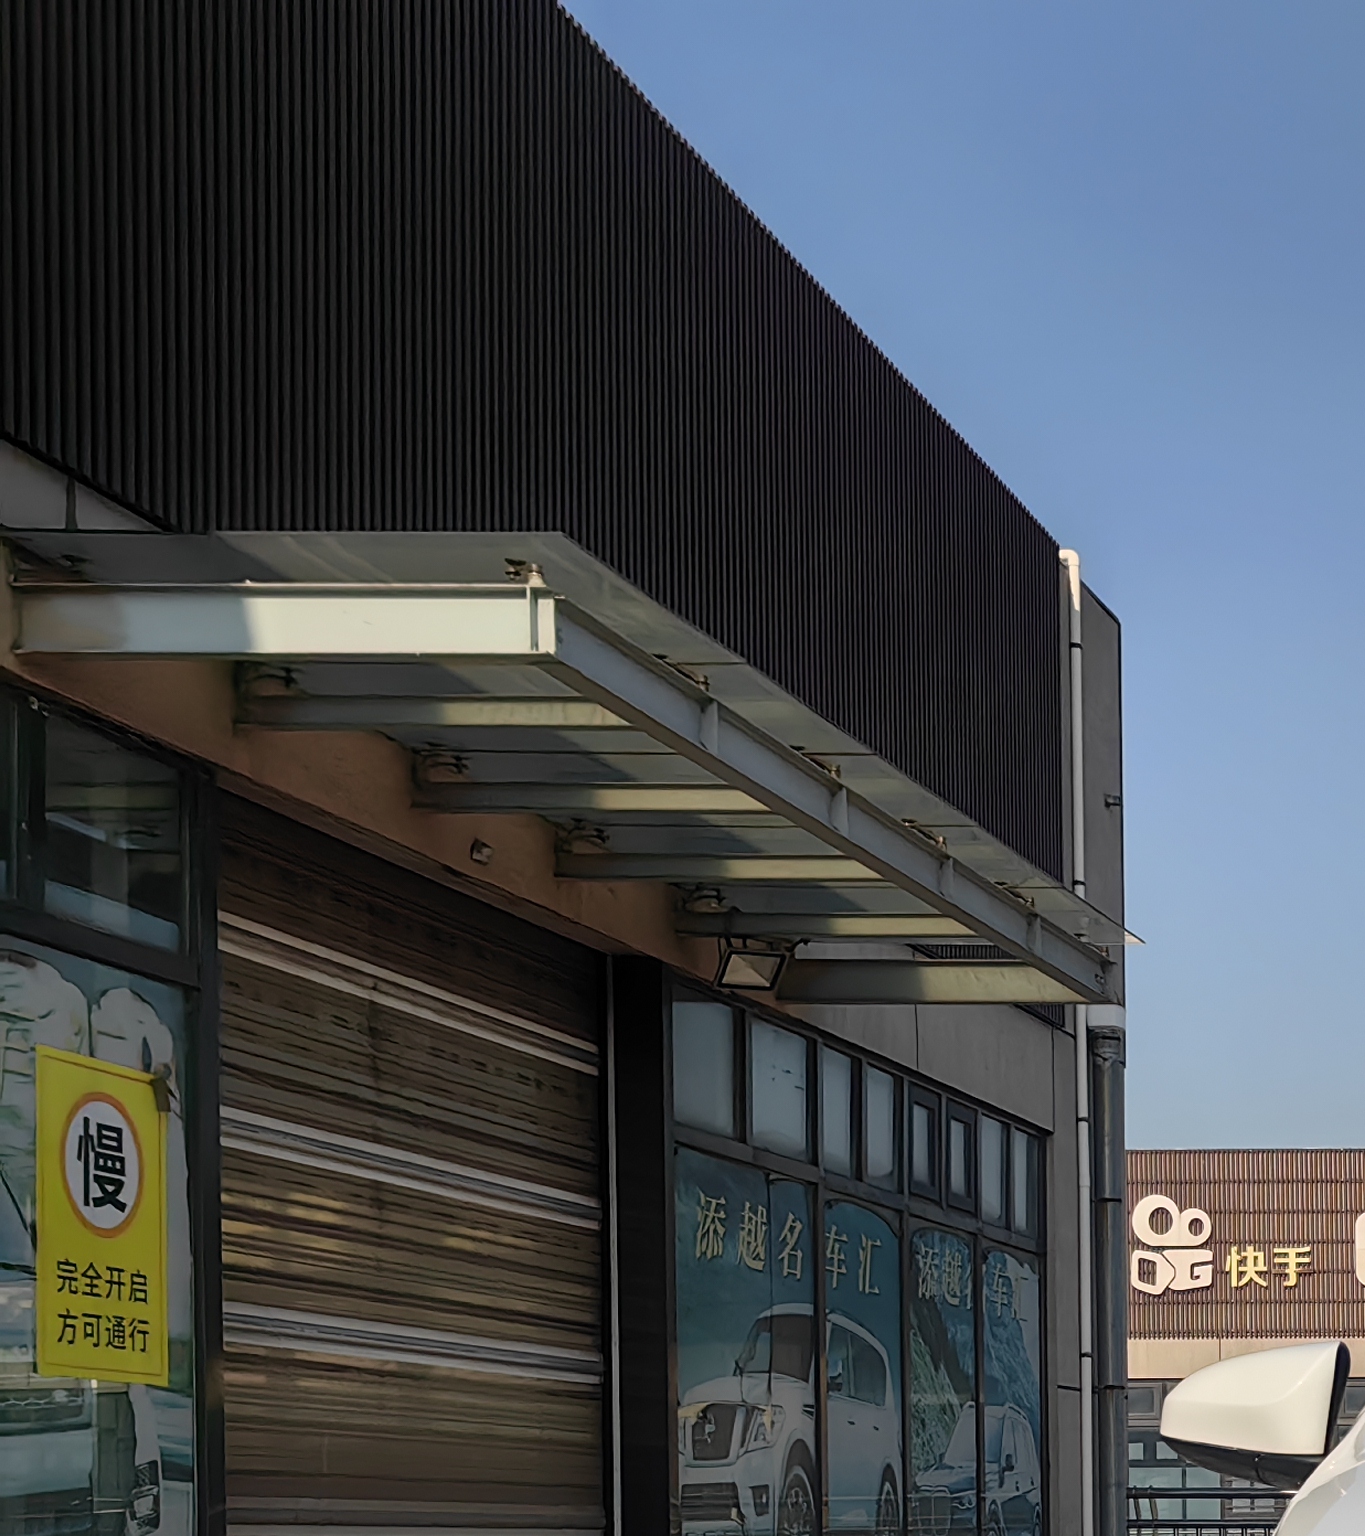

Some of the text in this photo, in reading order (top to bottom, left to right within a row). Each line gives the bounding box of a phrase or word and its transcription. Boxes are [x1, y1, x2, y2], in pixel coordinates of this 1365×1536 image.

[77, 1116, 128, 1214] 慢
[695, 1186, 882, 1295] 添越名车汇
[56, 1258, 149, 1305] 完全开启
[1225, 1245, 1312, 1288] 快手
[56, 1308, 150, 1353] 方可通行
